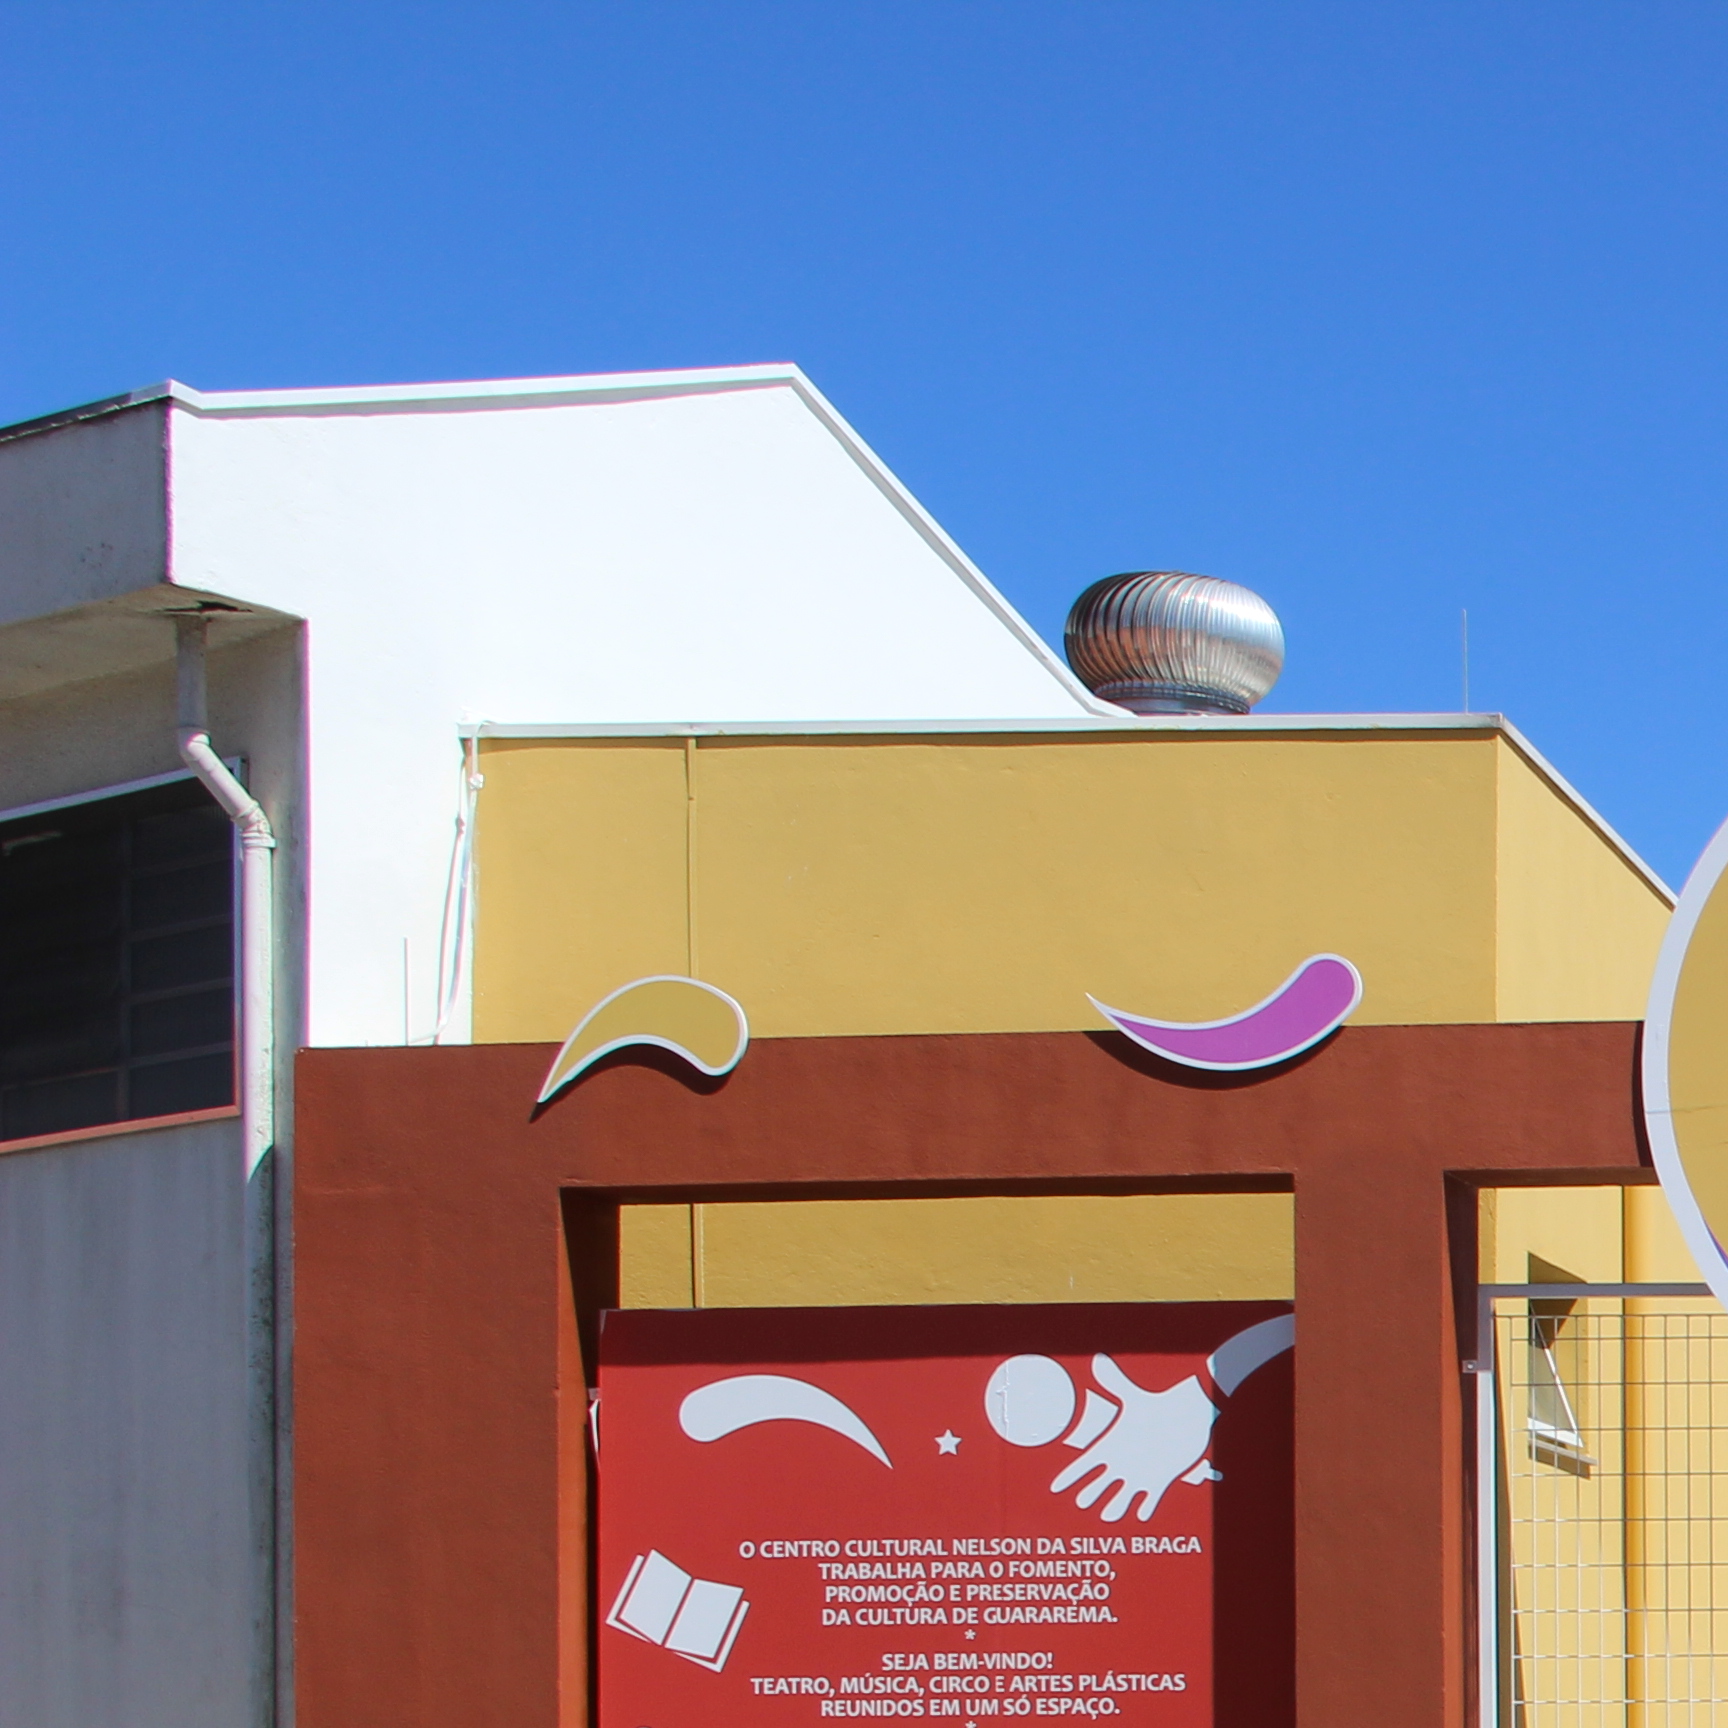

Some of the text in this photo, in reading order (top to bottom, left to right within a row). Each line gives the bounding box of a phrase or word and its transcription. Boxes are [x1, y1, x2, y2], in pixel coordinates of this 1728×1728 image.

[738, 1536, 1202, 1559] O CENTRO CULTURAL NELSON DA SILVA BRAGA
[817, 1559, 1116, 1581] TRABALHA PARA O FOMENTO,
[825, 1578, 1110, 1608] PROMOÇÃO E PRESERVAÇÃO
[821, 1605, 1118, 1626] DA CULTURA DE GUARAREMA.
[881, 1651, 1053, 1671] SEJA BEM-VINDO!
[749, 1670, 1186, 1698] TEATRO, MÚSICA, CIRCO E ARTES PLÁSTICAS
[820, 1693, 1121, 1720] REUNIDOS EM UM SÓ ESPAÇO.
